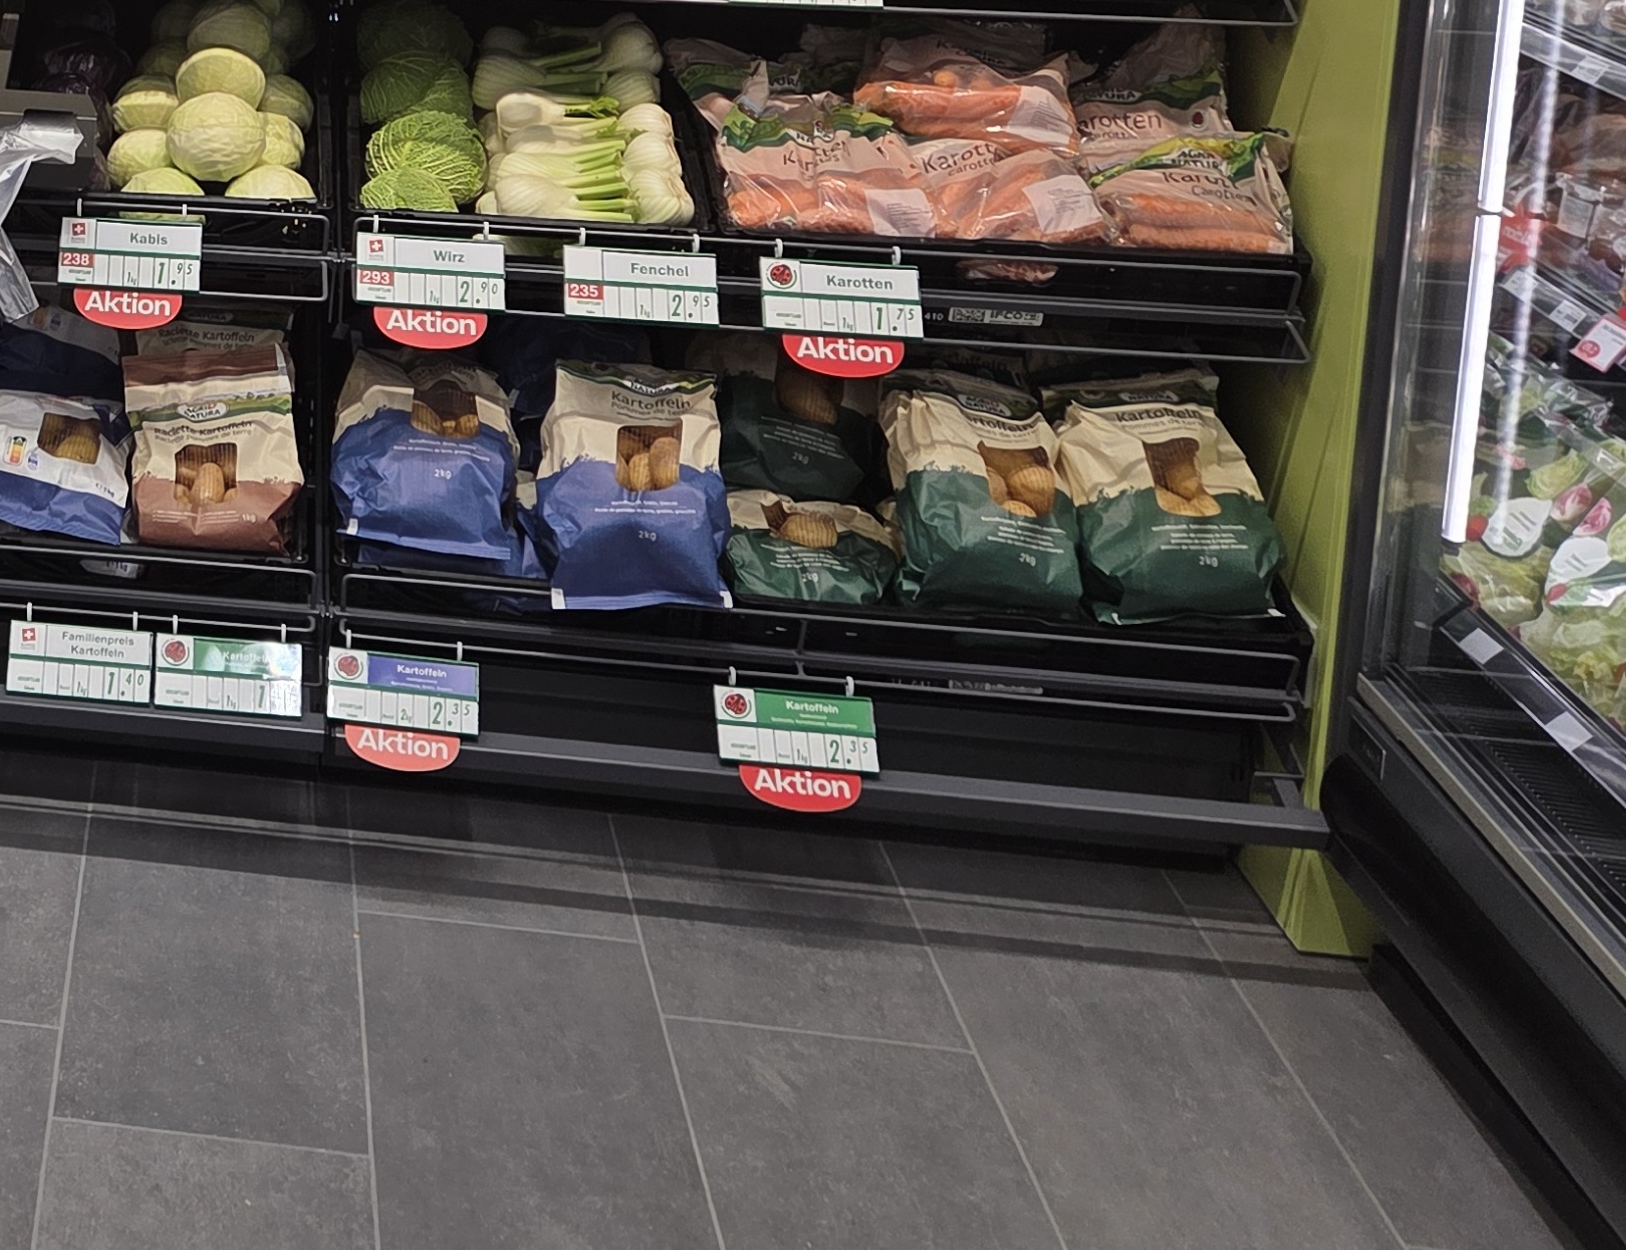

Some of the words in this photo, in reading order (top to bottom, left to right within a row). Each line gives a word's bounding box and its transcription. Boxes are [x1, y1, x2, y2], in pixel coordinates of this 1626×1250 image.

[130, 233, 168, 245] Kabis
[63, 253, 90, 265] 238
[433, 251, 465, 264] Wirz
[157, 262, 193, 286] 1.95
[362, 271, 390, 284] 293
[631, 262, 689, 277] Fenchel
[570, 283, 598, 297] 235
[826, 274, 893, 290] Karotten
[460, 281, 498, 304] 2.90
[85, 291, 171, 316] Aktion
[672, 294, 710, 318] 2.95
[386, 309, 476, 337] Aktion
[876, 307, 914, 332] 1.75
[203, 331, 255, 342] Kartoffeln
[796, 338, 894, 364] Aktion
[612, 391, 690, 410] Kartoffeln
[434, 469, 452, 479] 2kg
[639, 531, 656, 541] 2kg
[62, 631, 135, 646] Familienpreis
[71, 645, 124, 658] Kartoffeln
[397, 665, 447, 678] Kartoffeln
[107, 671, 144, 697] 1.40
[432, 702, 470, 726] 2.35
[786, 700, 839, 714] Kartoffeln
[357, 728, 448, 760] Aktion
[829, 739, 868, 765] 2.35
[755, 768, 851, 799] Aktion
